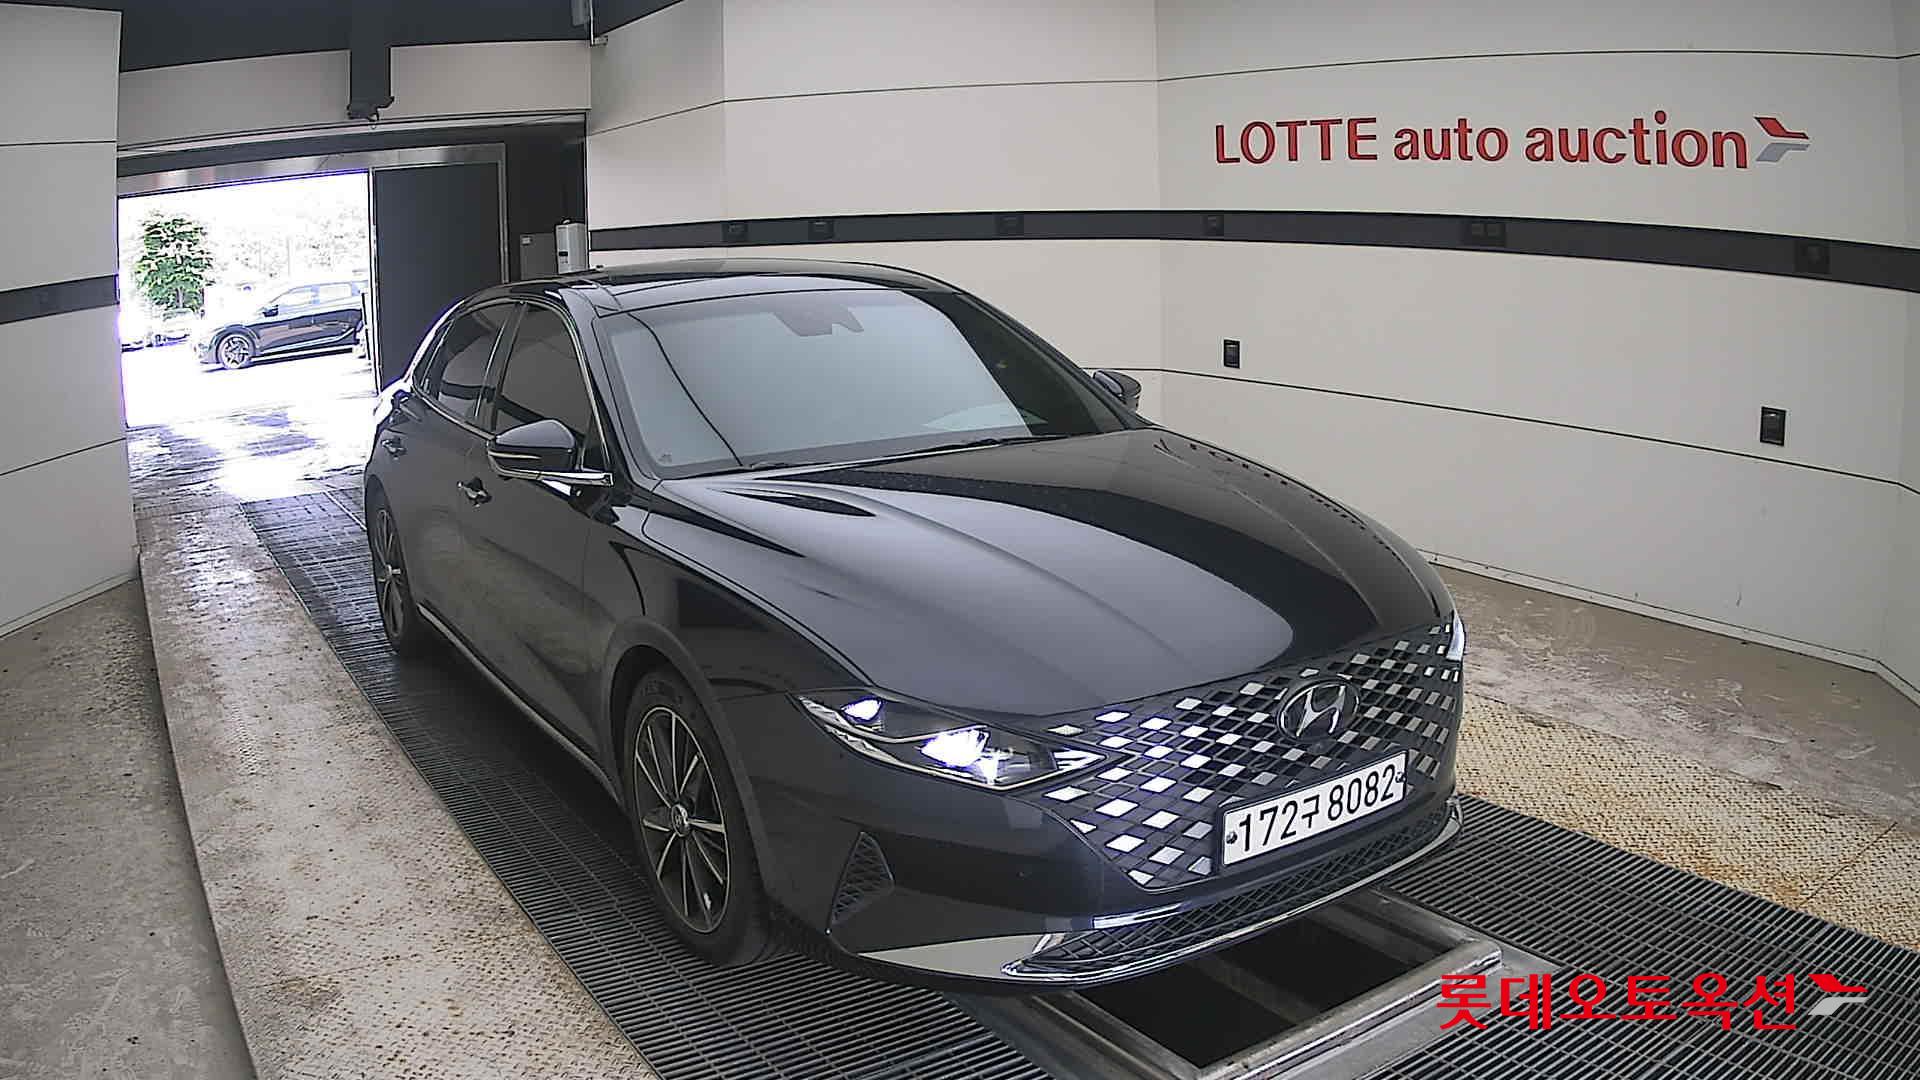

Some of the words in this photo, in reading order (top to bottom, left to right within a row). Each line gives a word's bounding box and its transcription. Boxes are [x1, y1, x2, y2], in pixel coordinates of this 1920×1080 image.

[1215, 117, 1378, 165] LOTTE
[1393, 117, 1510, 162] auto
[1524, 110, 1749, 169] auction
[1239, 794, 1320, 852] 172구
[1327, 764, 1396, 821] 8082
